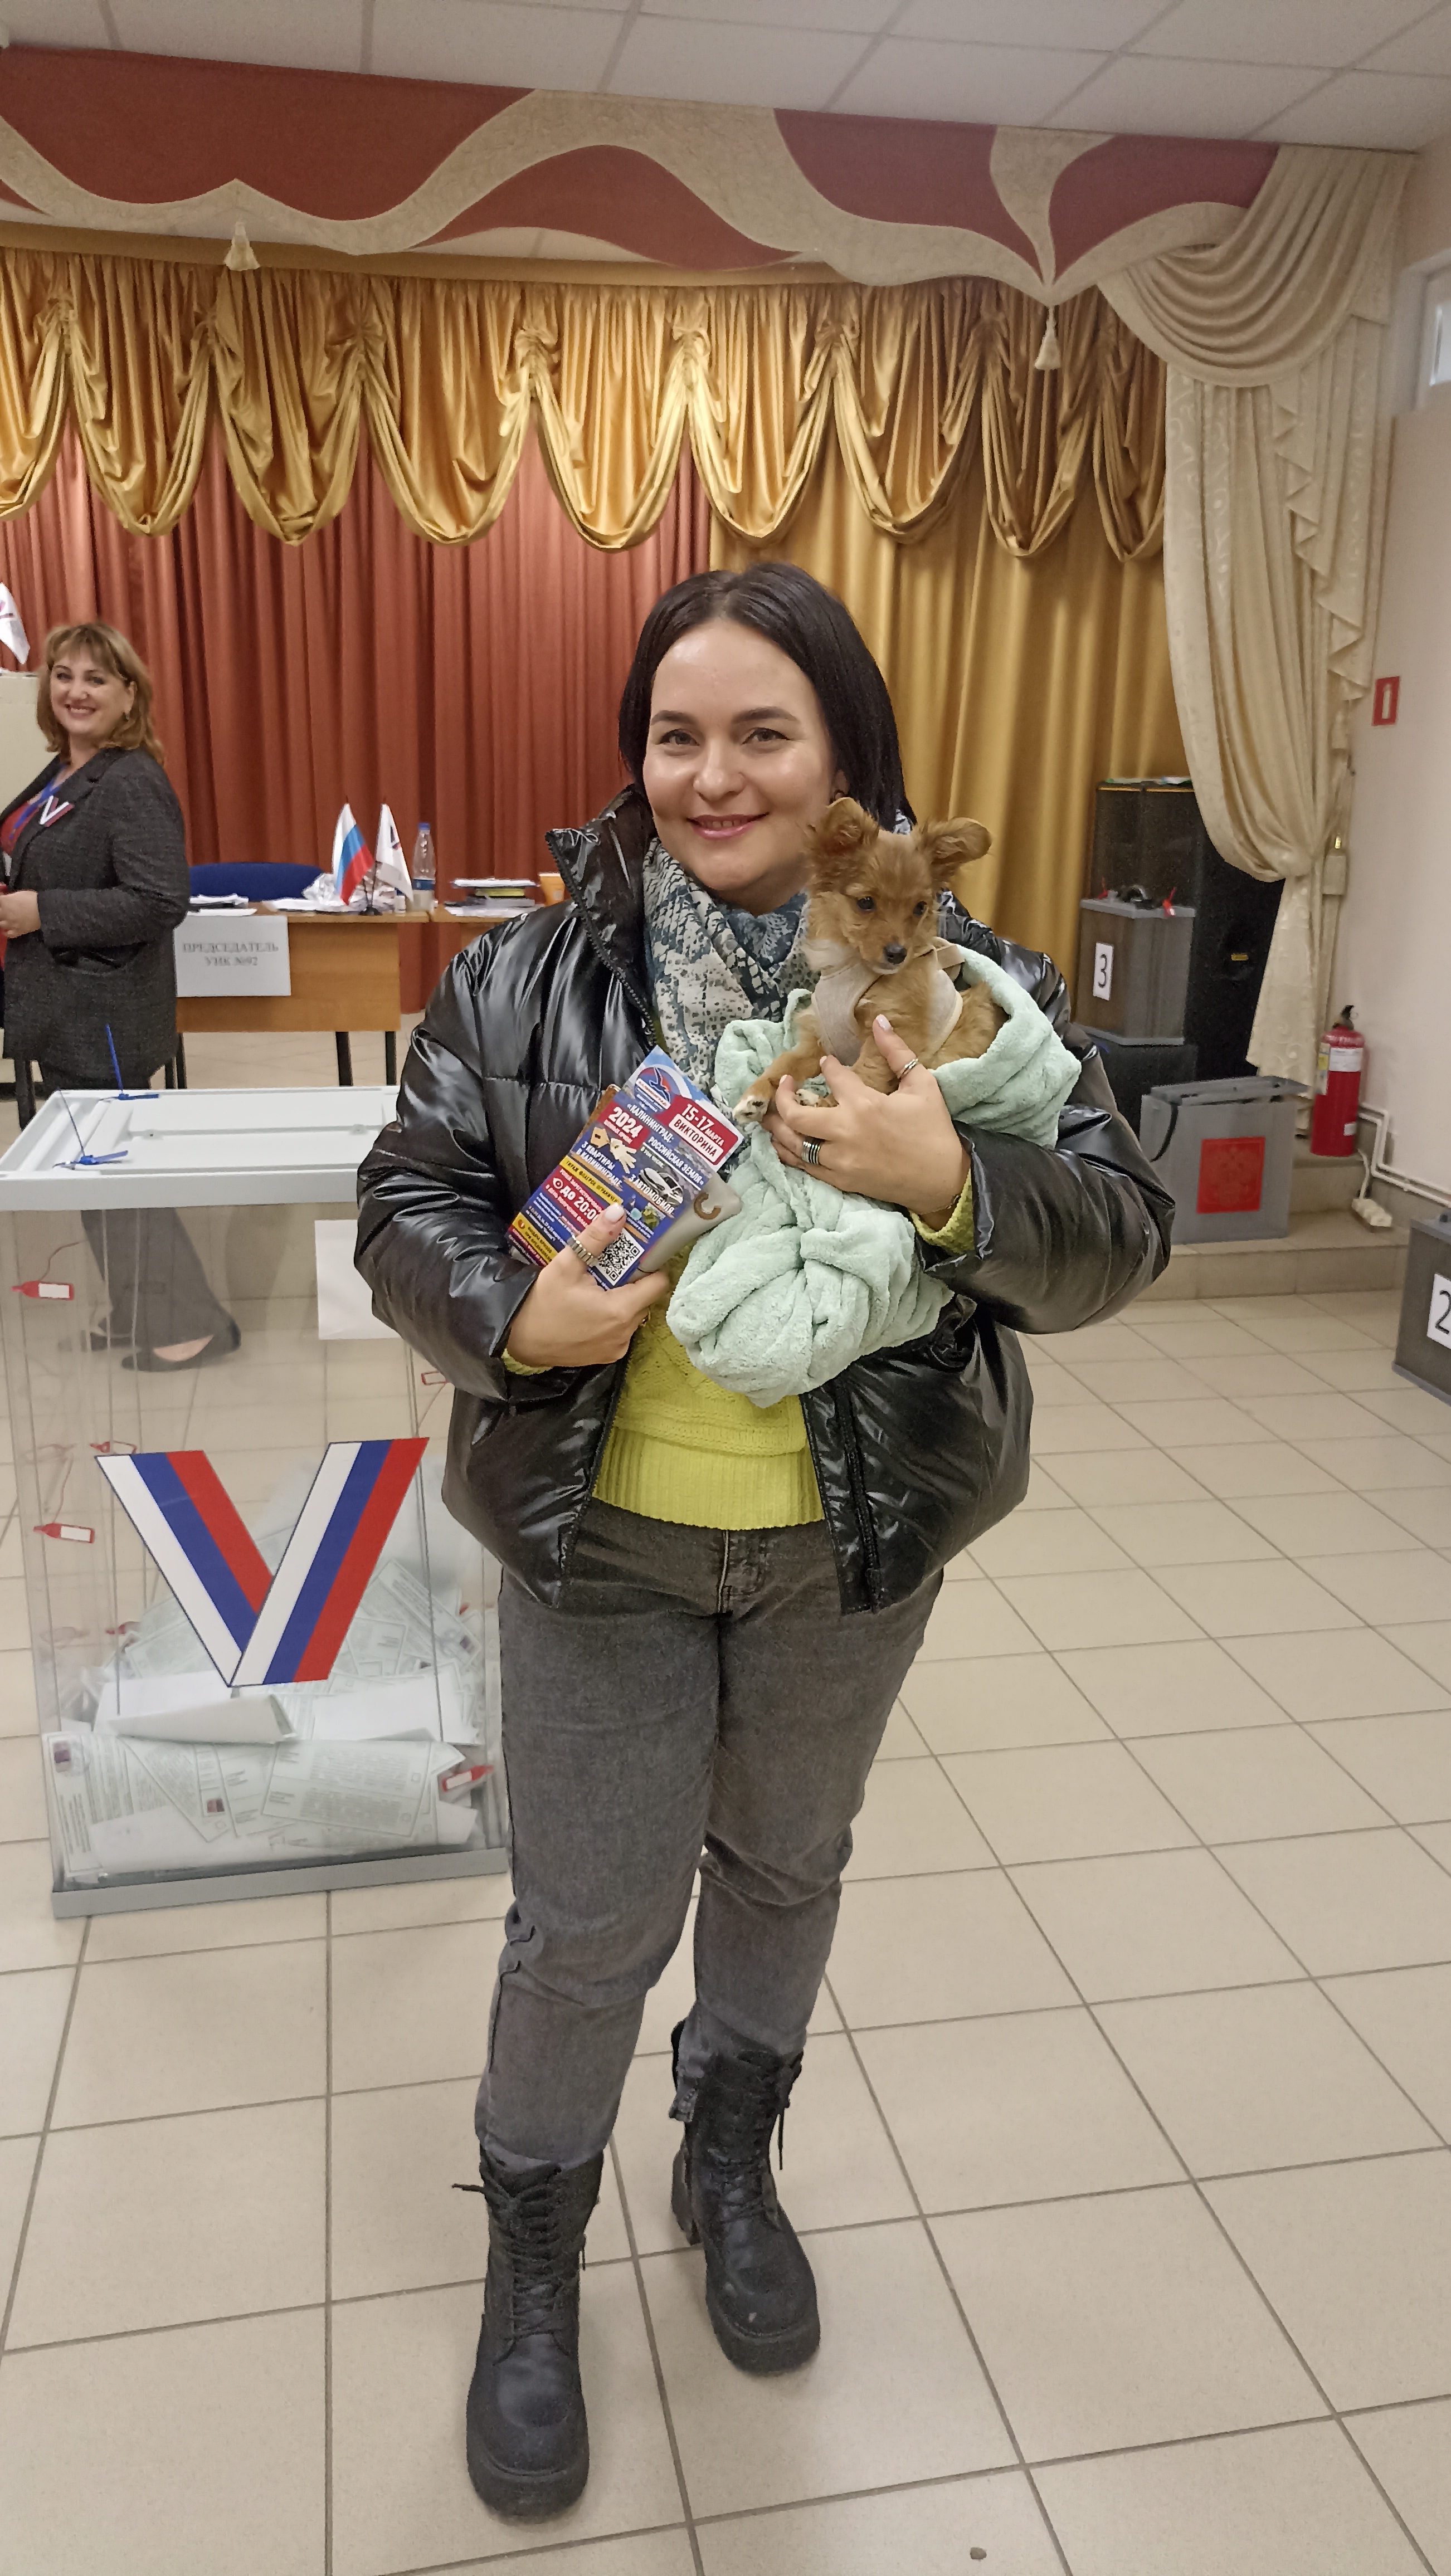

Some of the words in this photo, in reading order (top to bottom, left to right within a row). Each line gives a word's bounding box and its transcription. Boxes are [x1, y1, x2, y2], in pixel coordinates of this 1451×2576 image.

[183, 943, 279, 953] ПРЕДСЕДАТЕЛЬ
[204, 956, 231, 966] УИК
[1098, 953, 1108, 989] 3
[607, 1105, 644, 1139] 2024
[625, 1101, 675, 1144] «КАЛИНИНГРАД:
[673, 1118, 718, 1157] ВИКТОРИНА
[680, 1102, 714, 1134] 15-17
[704, 1128, 724, 1146] МАРТА
[580, 1151, 623, 1187] КАЛИНИНГРАДЕ
[581, 1140, 588, 1149] 3
[585, 1144, 616, 1170] КВАРТИРЫ
[647, 1135, 684, 1168] РОССИЙСКАЯ
[680, 1163, 706, 1187] ЗЕМЛЯ»
[558, 1184, 577, 1202] ДО
[628, 1174, 636, 1183] 3
[632, 1177, 675, 1215] АВТОМОБИЛЯ
[1435, 1290, 1451, 1334] 2
